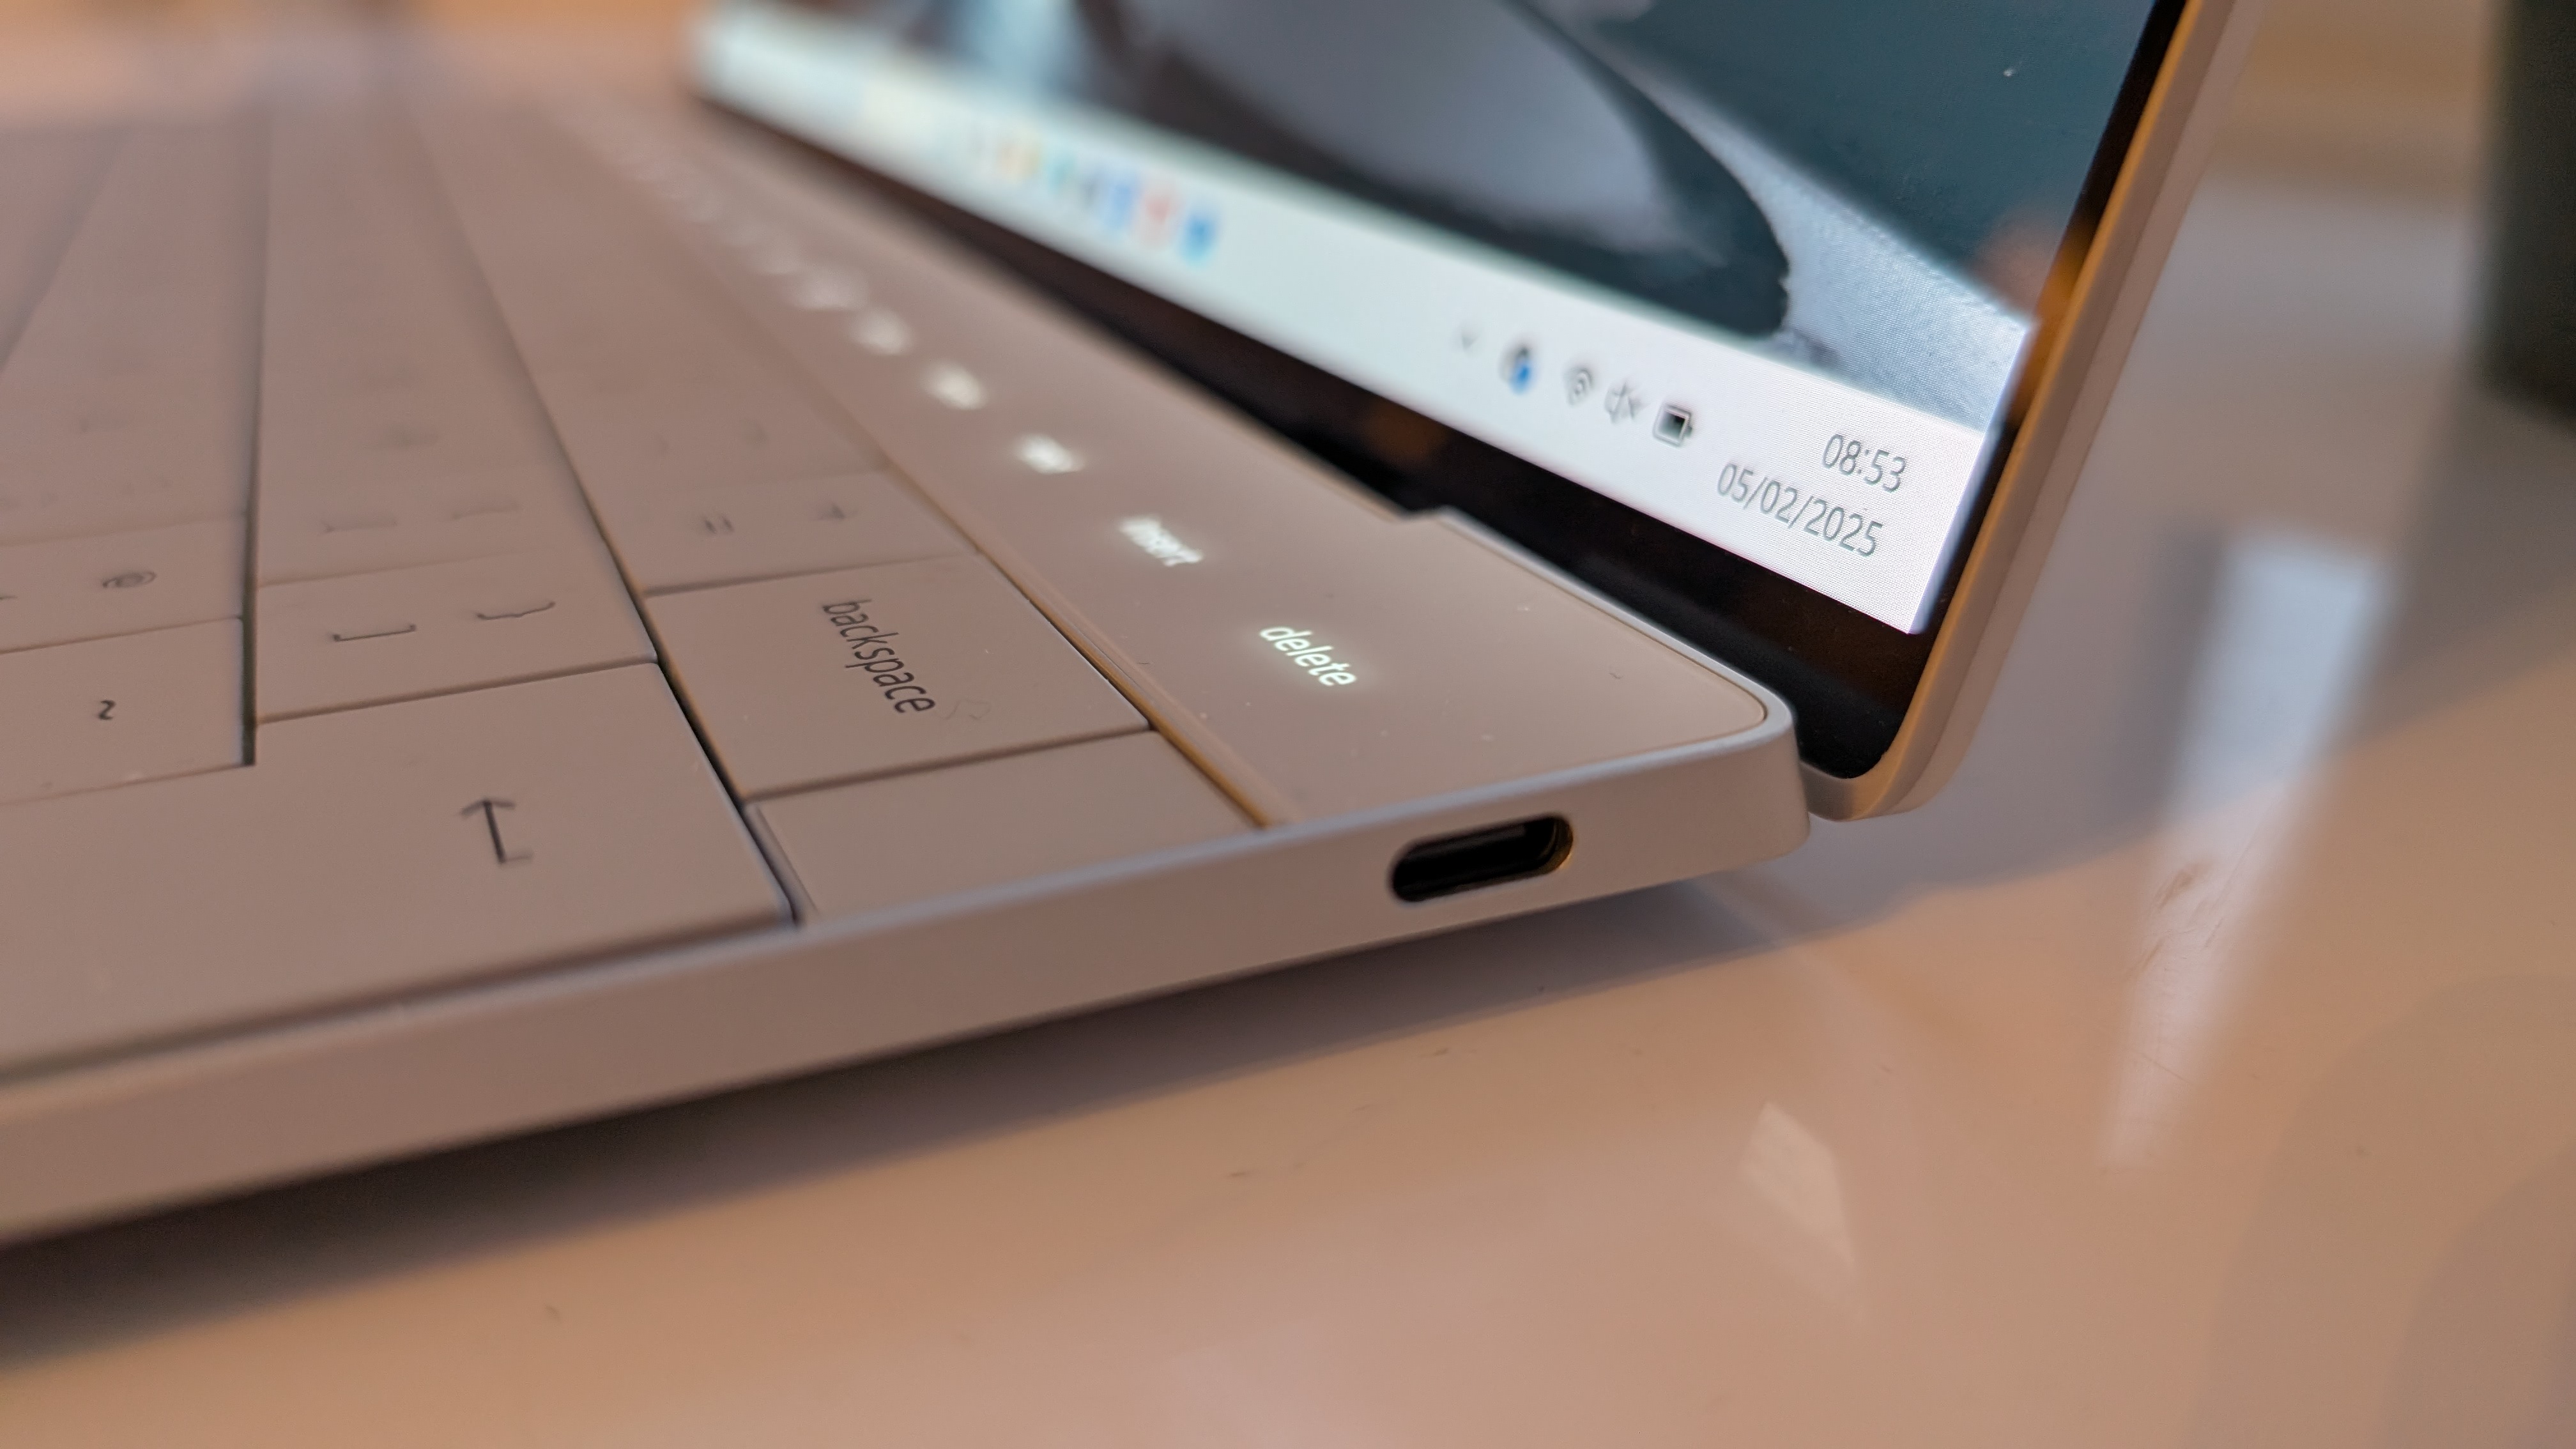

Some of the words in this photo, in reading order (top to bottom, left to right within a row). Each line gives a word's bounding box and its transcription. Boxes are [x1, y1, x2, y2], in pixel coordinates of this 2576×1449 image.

[1823, 433, 1906, 493] 08:53
[1717, 463, 1884, 558] 05/02/2025
[822, 599, 936, 714] backspace
[1259, 626, 1358, 686] delete
